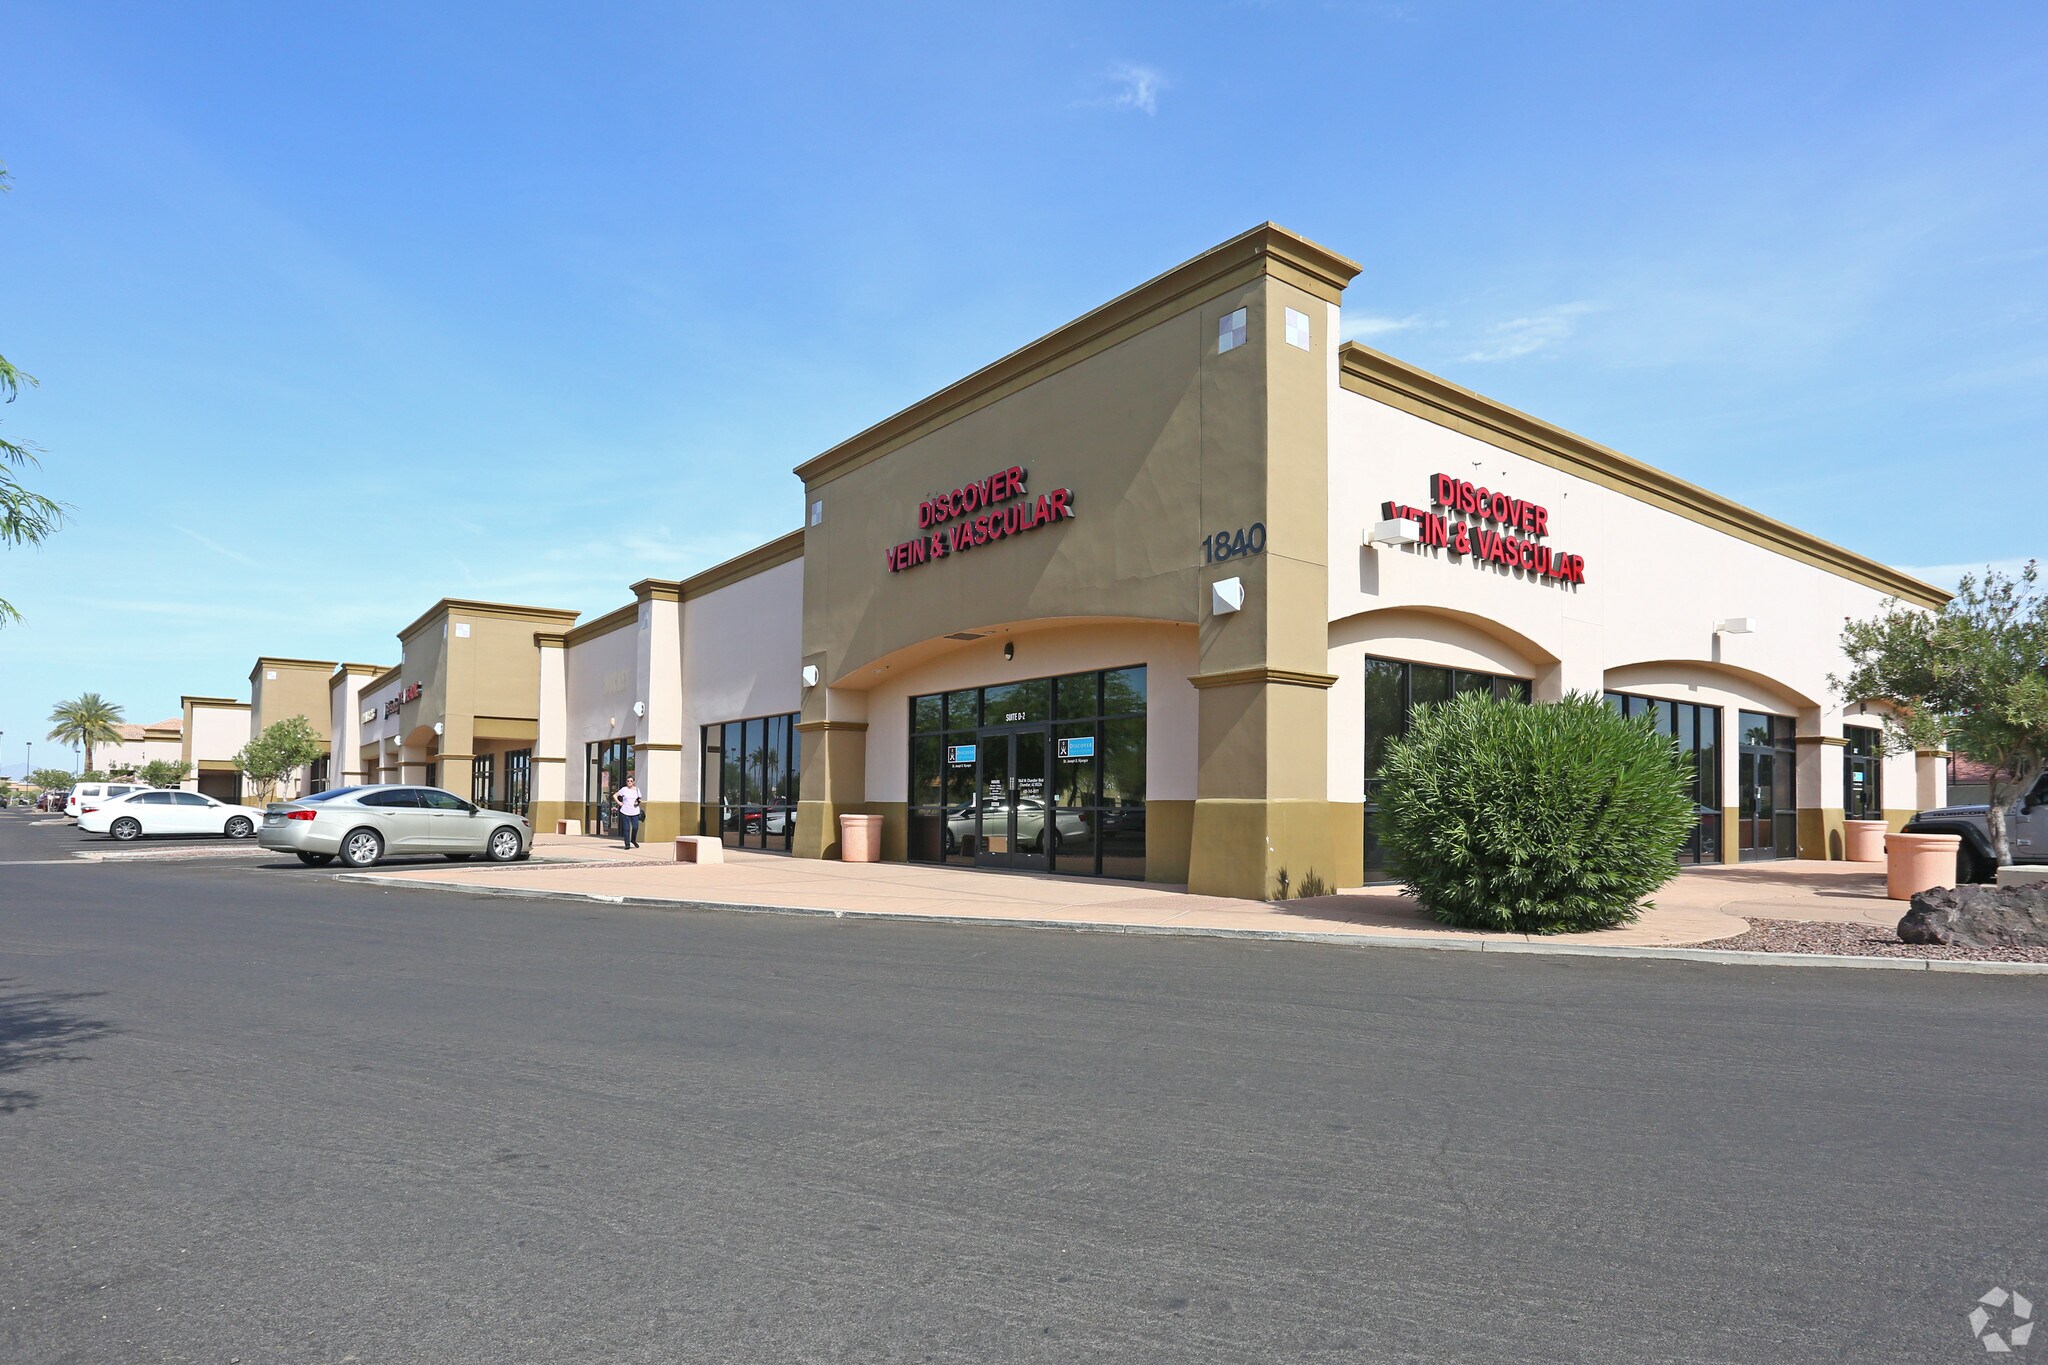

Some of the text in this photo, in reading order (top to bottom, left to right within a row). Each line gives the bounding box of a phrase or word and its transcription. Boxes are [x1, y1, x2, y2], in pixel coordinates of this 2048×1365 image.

[919, 466, 1028, 529] DISCOVER
[1430, 473, 1549, 537] DISCOVER
[886, 488, 1075, 573] VEIN & VASCULAR
[1203, 522, 1267, 563] 1840
[1448, 521, 1471, 555] &
[1469, 527, 1585, 584] VASCULAR
[1006, 713, 1018, 722] SUITE
